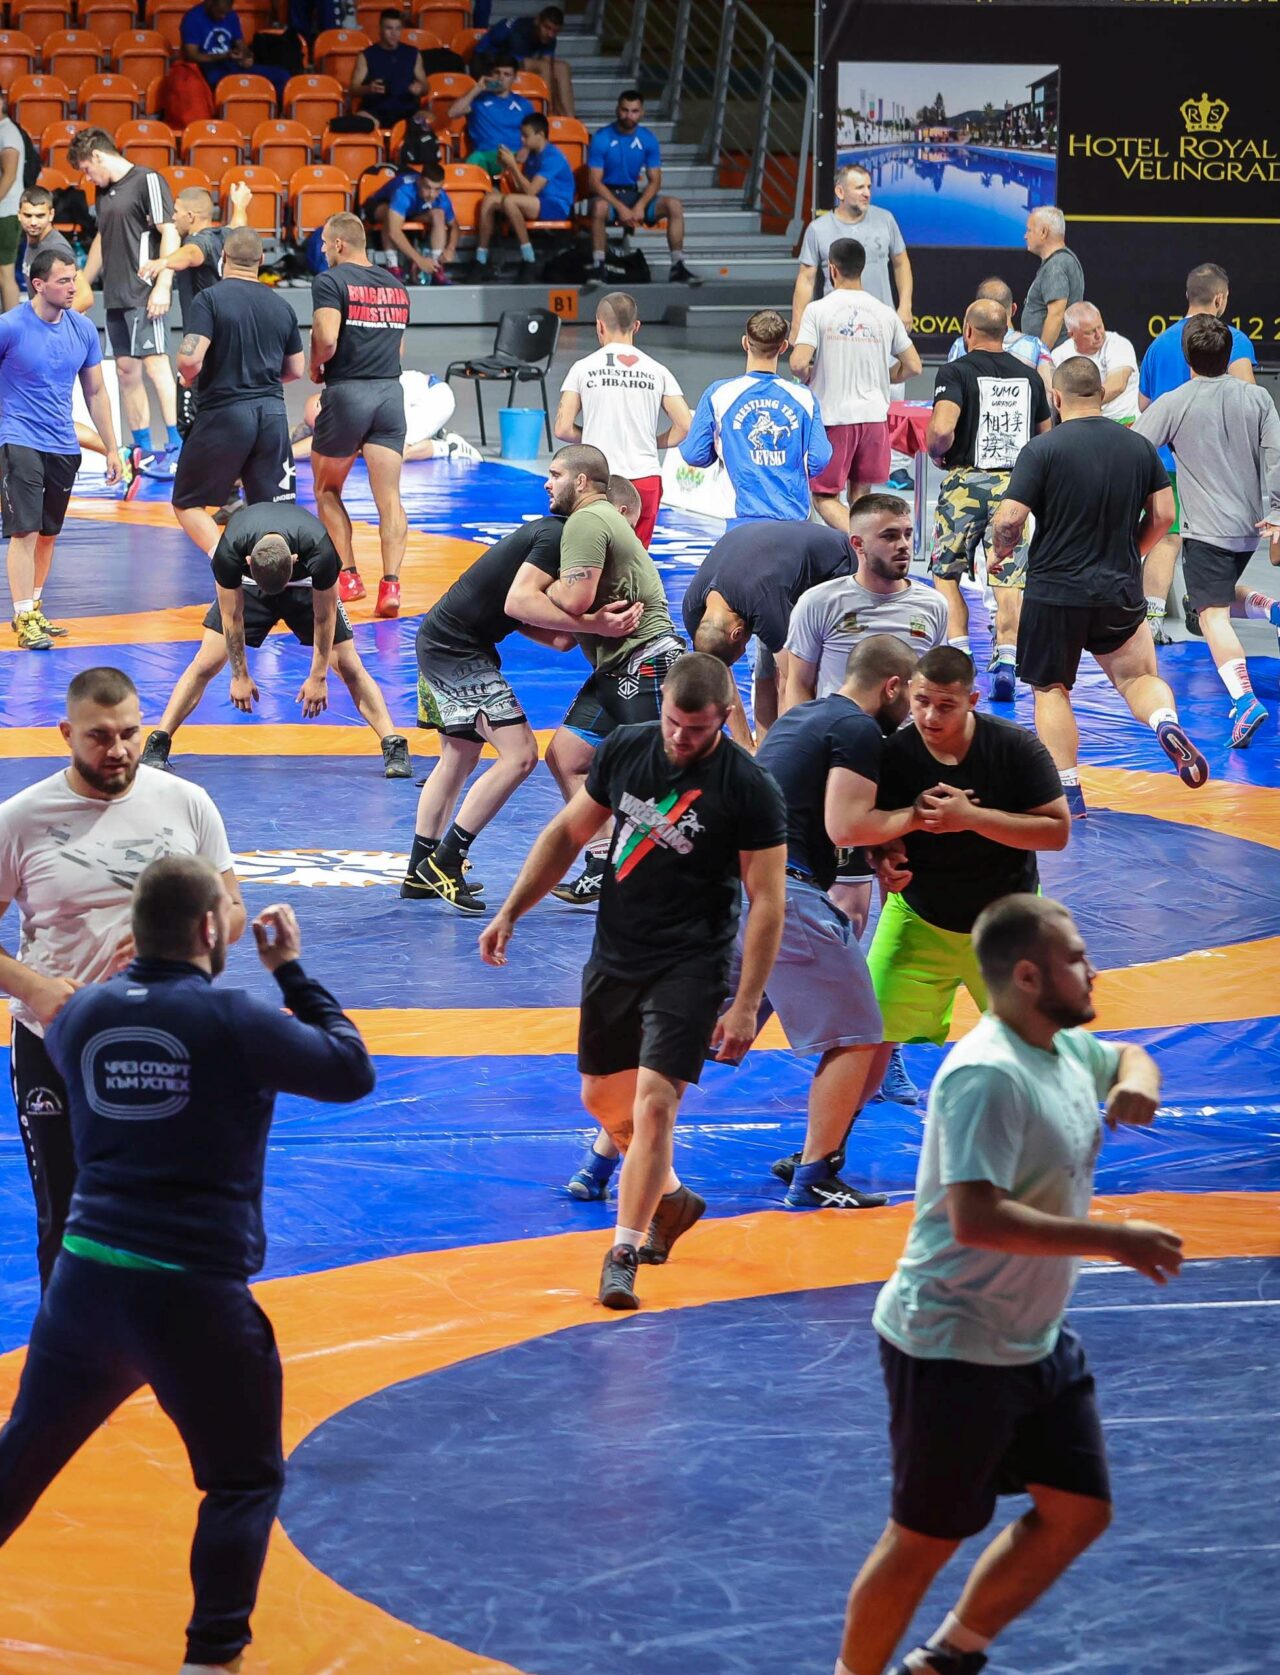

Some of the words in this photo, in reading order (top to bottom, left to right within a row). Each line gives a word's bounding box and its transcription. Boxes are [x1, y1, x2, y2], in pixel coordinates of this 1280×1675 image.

[1069, 134, 1169, 157] HOTEL
[1180, 136, 1278, 160] ROYAL
[347, 284, 409, 304] BULGARIA
[555, 296, 572, 312] B1
[606, 353, 615, 366] I
[587, 368, 655, 381] WRESTLING
[991, 385, 1020, 398] SUMO
[732, 399, 780, 430] WRESTLING
[781, 404, 800, 431] TEAM
[750, 450, 786, 467] LEVSKI
[618, 791, 694, 854] WRESTLING
[140, 1061, 191, 1076] СПОРТ
[106, 1076, 139, 1089] КЪМ
[141, 1076, 190, 1092] УСПЕХ
